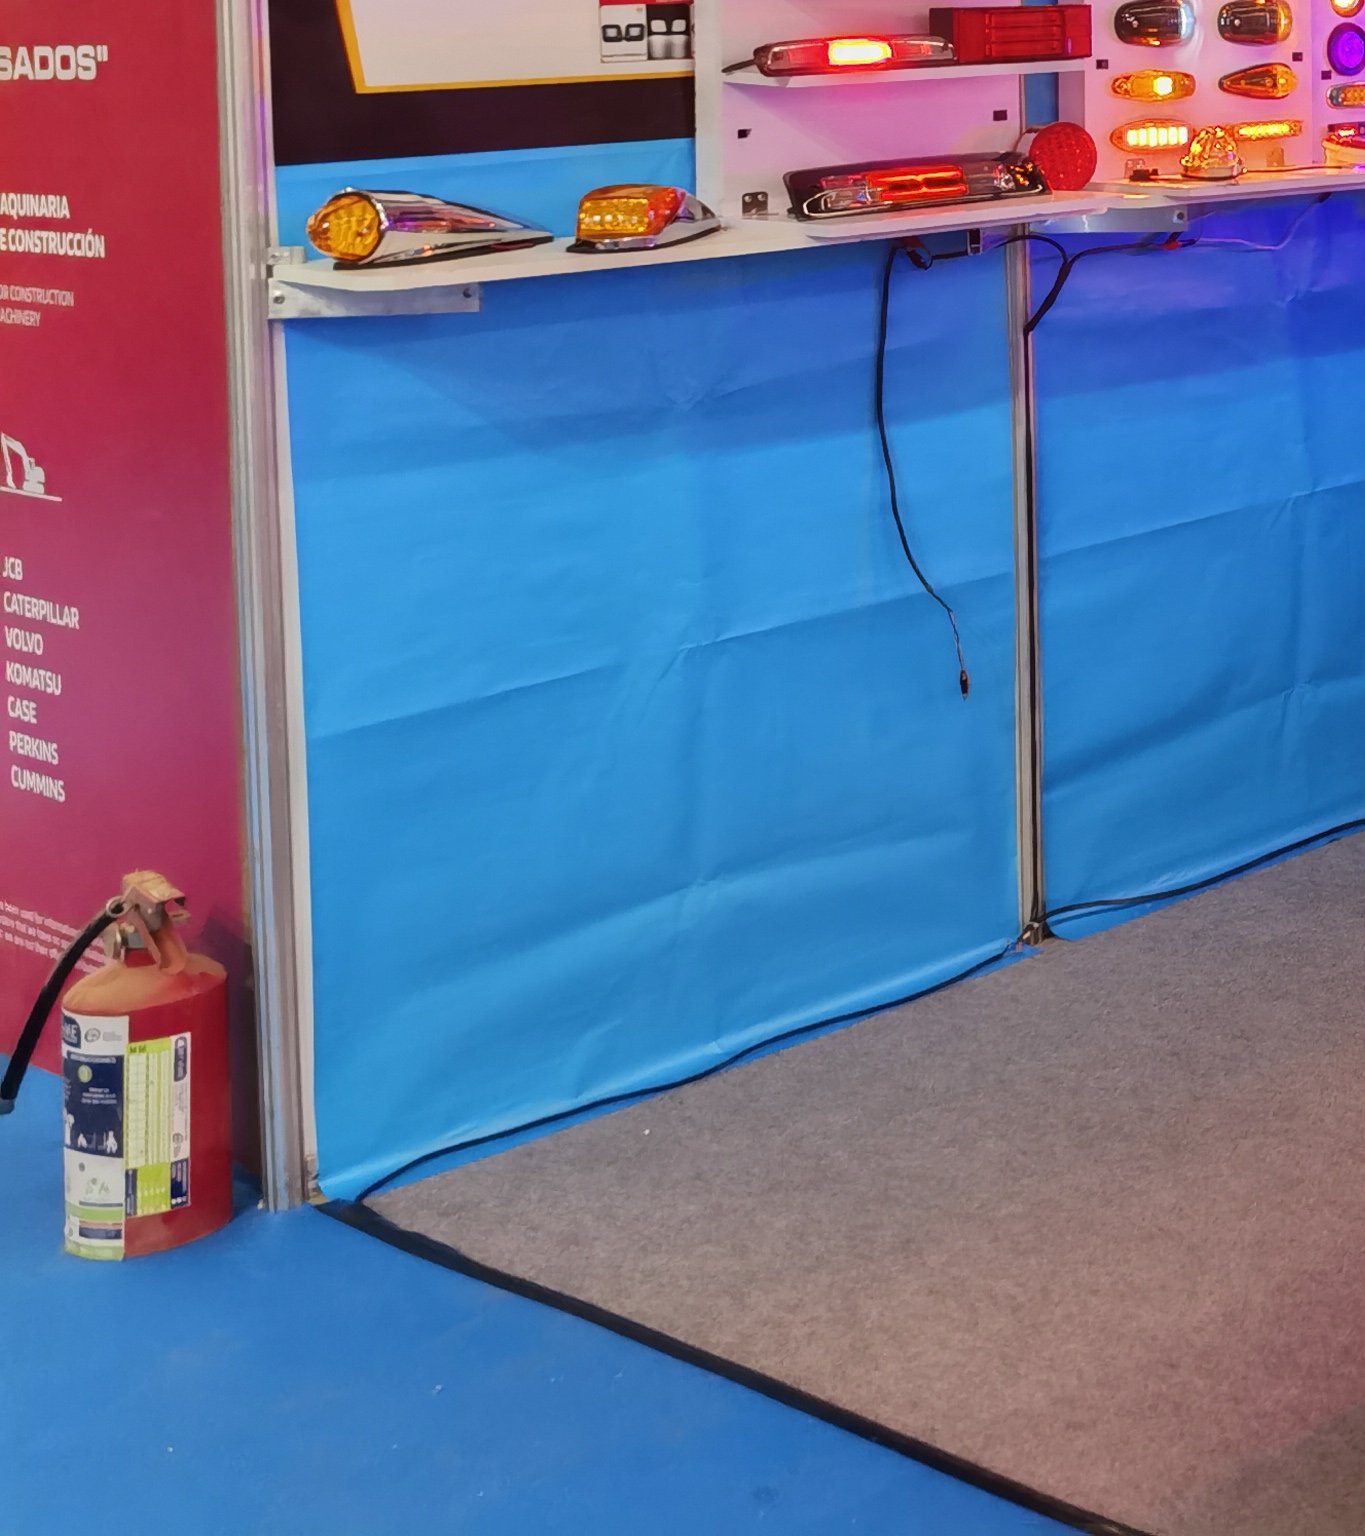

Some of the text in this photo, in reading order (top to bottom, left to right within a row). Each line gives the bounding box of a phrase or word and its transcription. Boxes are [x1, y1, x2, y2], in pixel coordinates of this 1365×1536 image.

[8, 228, 105, 258] CONSTRUCCIÓN
[10, 285, 74, 307] CONSTRUCTION
[3, 555, 23, 581] JCB
[4, 591, 80, 630] CATERPILLAR
[5, 625, 44, 655] VOLVO
[6, 660, 62, 695] KOMATSU
[7, 695, 37, 724] CASE
[9, 730, 59, 765] PERKINS
[11, 764, 66, 802] CUMMINS
